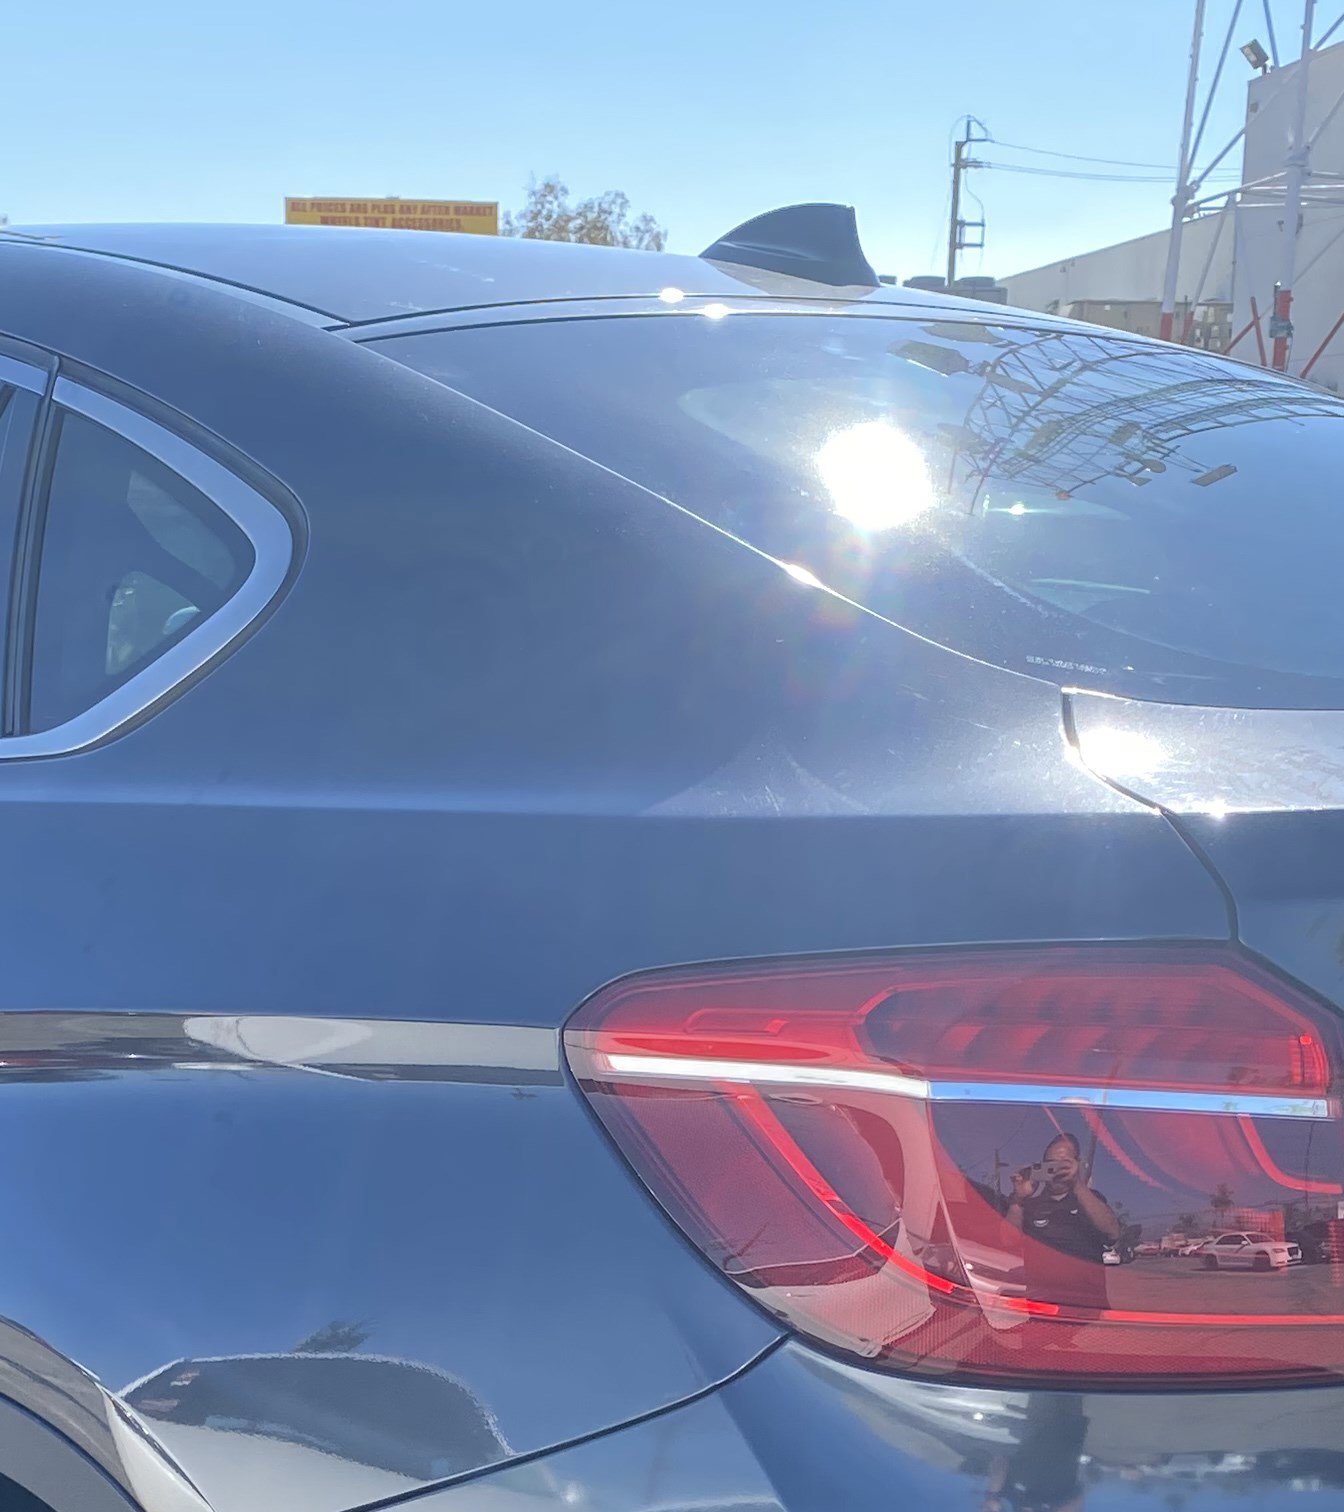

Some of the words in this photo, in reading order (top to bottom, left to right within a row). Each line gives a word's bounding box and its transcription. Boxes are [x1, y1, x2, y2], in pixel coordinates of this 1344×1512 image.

[310, 202, 346, 213] PRICES
[350, 202, 368, 214] ARE
[371, 203, 396, 214] PLUS
[399, 204, 417, 215] ANY
[420, 204, 450, 215] AFTER
[454, 205, 493, 216] MARKET
